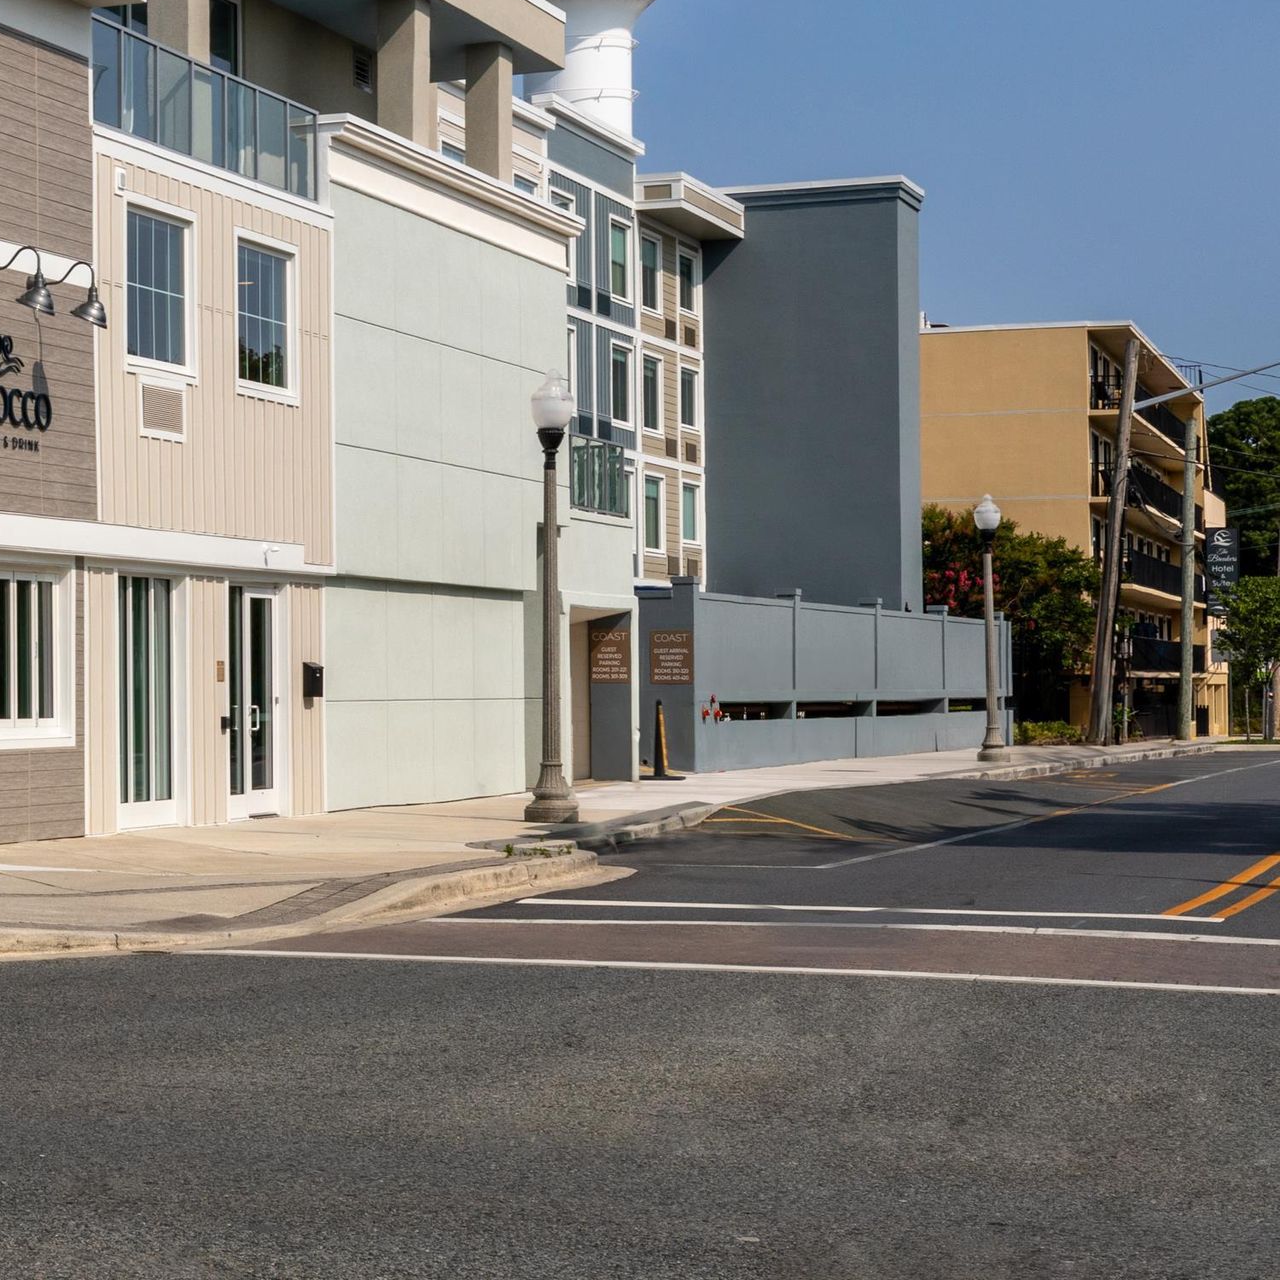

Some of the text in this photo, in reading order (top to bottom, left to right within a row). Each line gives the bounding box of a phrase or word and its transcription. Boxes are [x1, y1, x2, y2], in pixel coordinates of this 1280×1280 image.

[3, 435, 9, 449] &
[12, 437, 40, 453] DRINK
[592, 632, 628, 641] COAST
[654, 634, 688, 642] COAST
